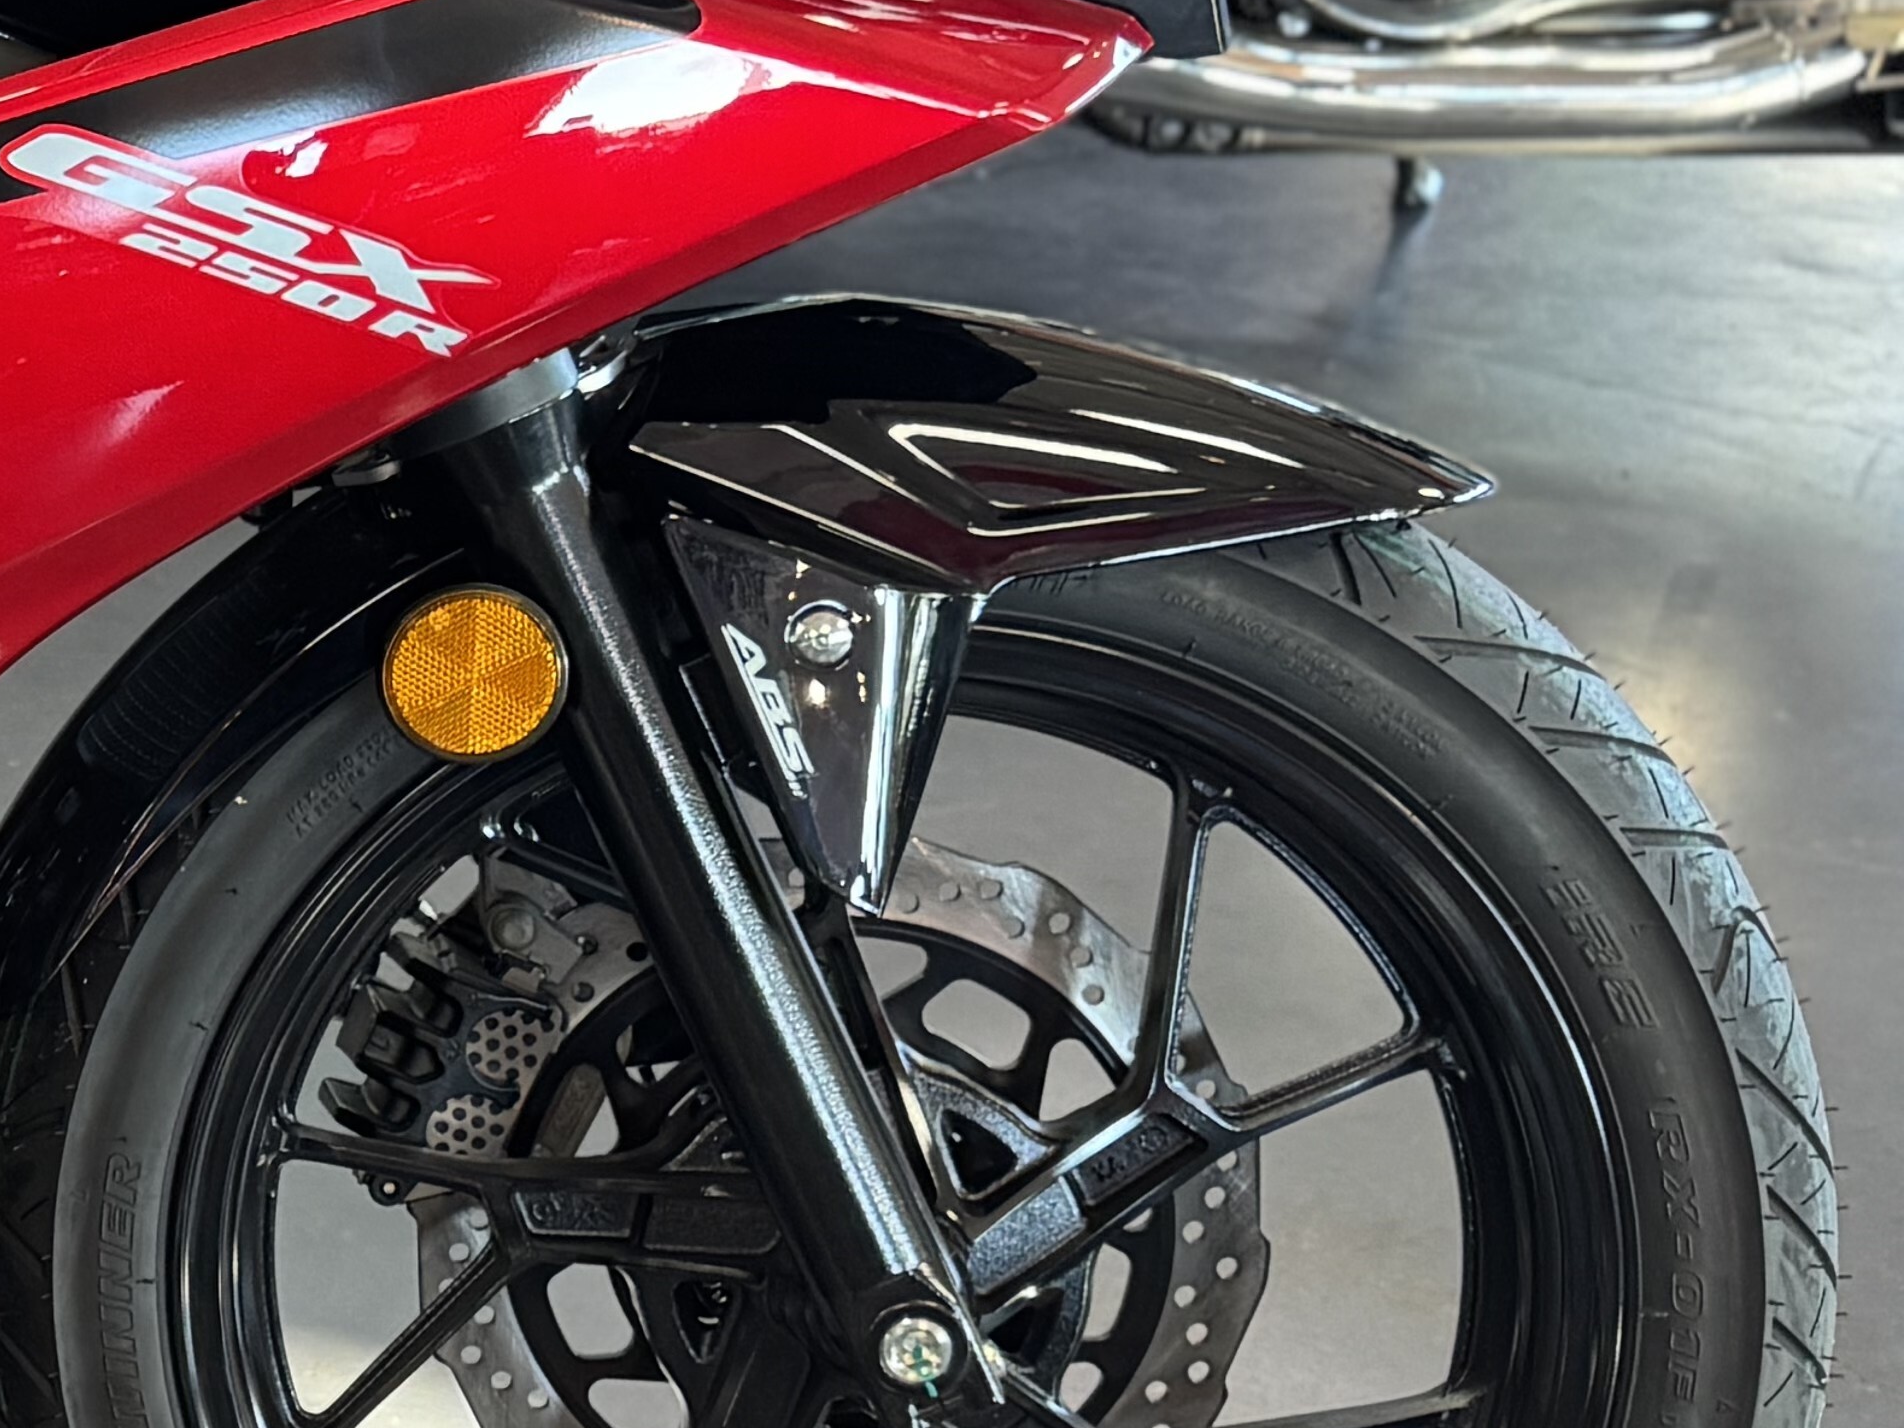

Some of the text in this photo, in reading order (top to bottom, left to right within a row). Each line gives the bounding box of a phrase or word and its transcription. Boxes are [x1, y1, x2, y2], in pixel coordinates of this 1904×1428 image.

[7, 132, 494, 314] GSX
[121, 223, 469, 357] 250R
[721, 623, 816, 782] ABS
